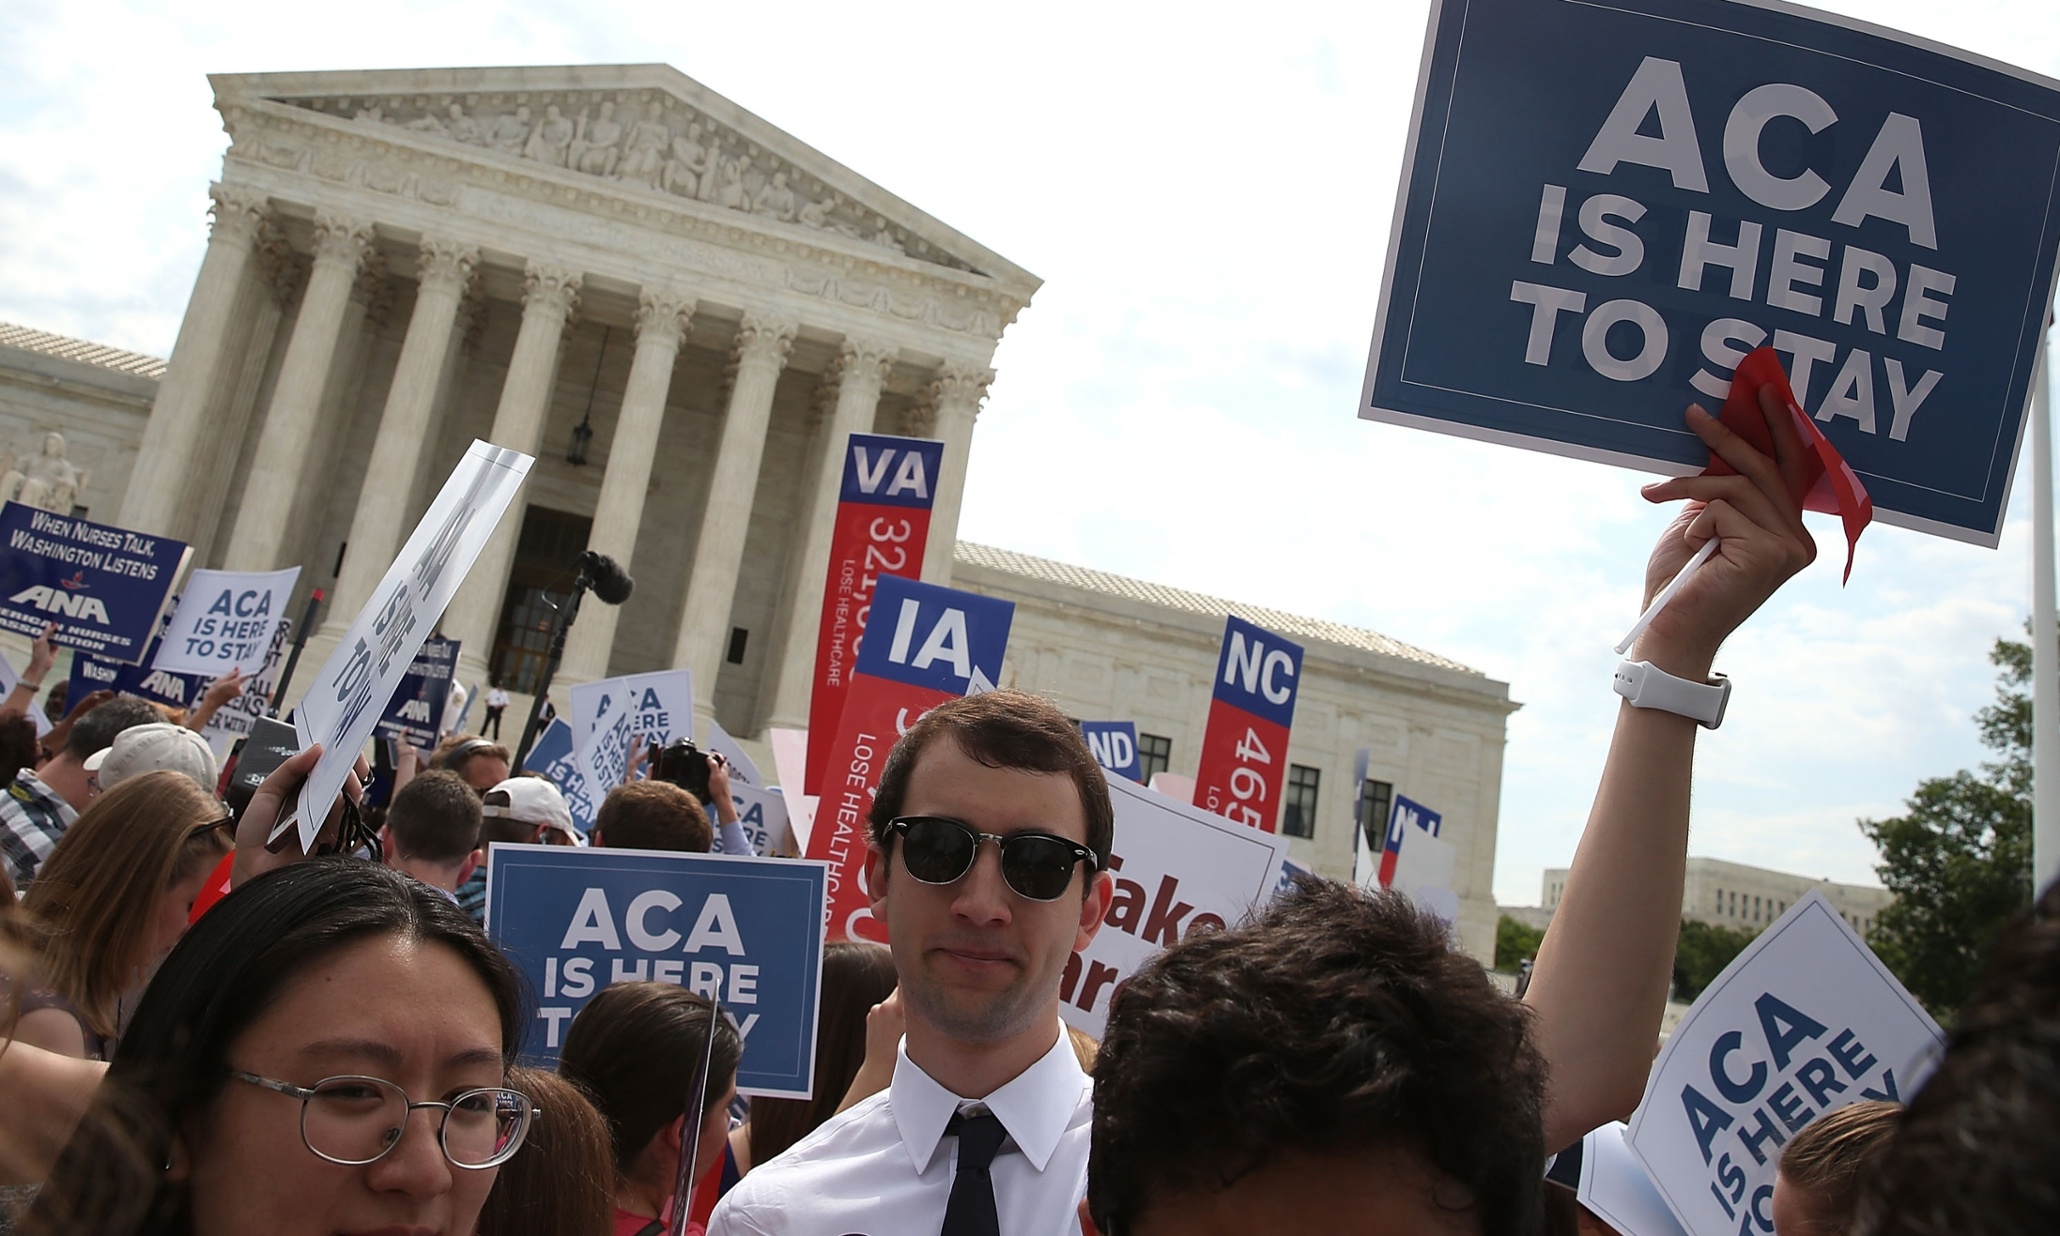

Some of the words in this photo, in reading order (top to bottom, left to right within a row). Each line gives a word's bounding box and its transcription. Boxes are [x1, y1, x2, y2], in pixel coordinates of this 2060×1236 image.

[1577, 56, 1938, 251] ACA
[1531, 184, 1648, 277] IS
[1678, 210, 1957, 351] HERE
[1510, 280, 1669, 381] TO
[1689, 317, 1944, 442] STAY
[853, 446, 929, 499] VA
[9, 529, 102, 568] WASHINGTON
[103, 552, 158, 580] LISTENS
[30, 511, 69, 538] WHEN
[75, 521, 122, 551] NURSES
[124, 533, 155, 558] TALK,
[839, 560, 855, 594] LOSE
[0, 606, 65, 632] ERICAN
[67, 625, 132, 647] NURSES
[9, 584, 110, 625] ANA
[193, 618, 216, 636] IS
[220, 620, 268, 639] HERE
[207, 589, 272, 618] ACA
[372, 579, 408, 636] IS
[0, 617, 105, 651] ASSOIATION
[186, 638, 215, 656] TO
[217, 641, 260, 661] STAY
[827, 597, 850, 687] HEALTHCARE
[889, 598, 971, 679] IA
[83, 661, 118, 683] WASHIN
[139, 671, 186, 703] ANA
[332, 636, 371, 702] TO
[1224, 630, 1295, 705] NC
[396, 699, 431, 724] ANA
[545, 760, 568, 781] IS
[846, 733, 876, 789] LOSE
[1088, 731, 1134, 769] ND
[1224, 727, 1272, 830] 465
[560, 887, 746, 956] ACA
[544, 957, 595, 998] IS
[611, 958, 760, 1005] HERE
[1681, 992, 1828, 1167] ACA
[1711, 1152, 1746, 1222] IS
[1737, 1028, 1877, 1166] HERE
